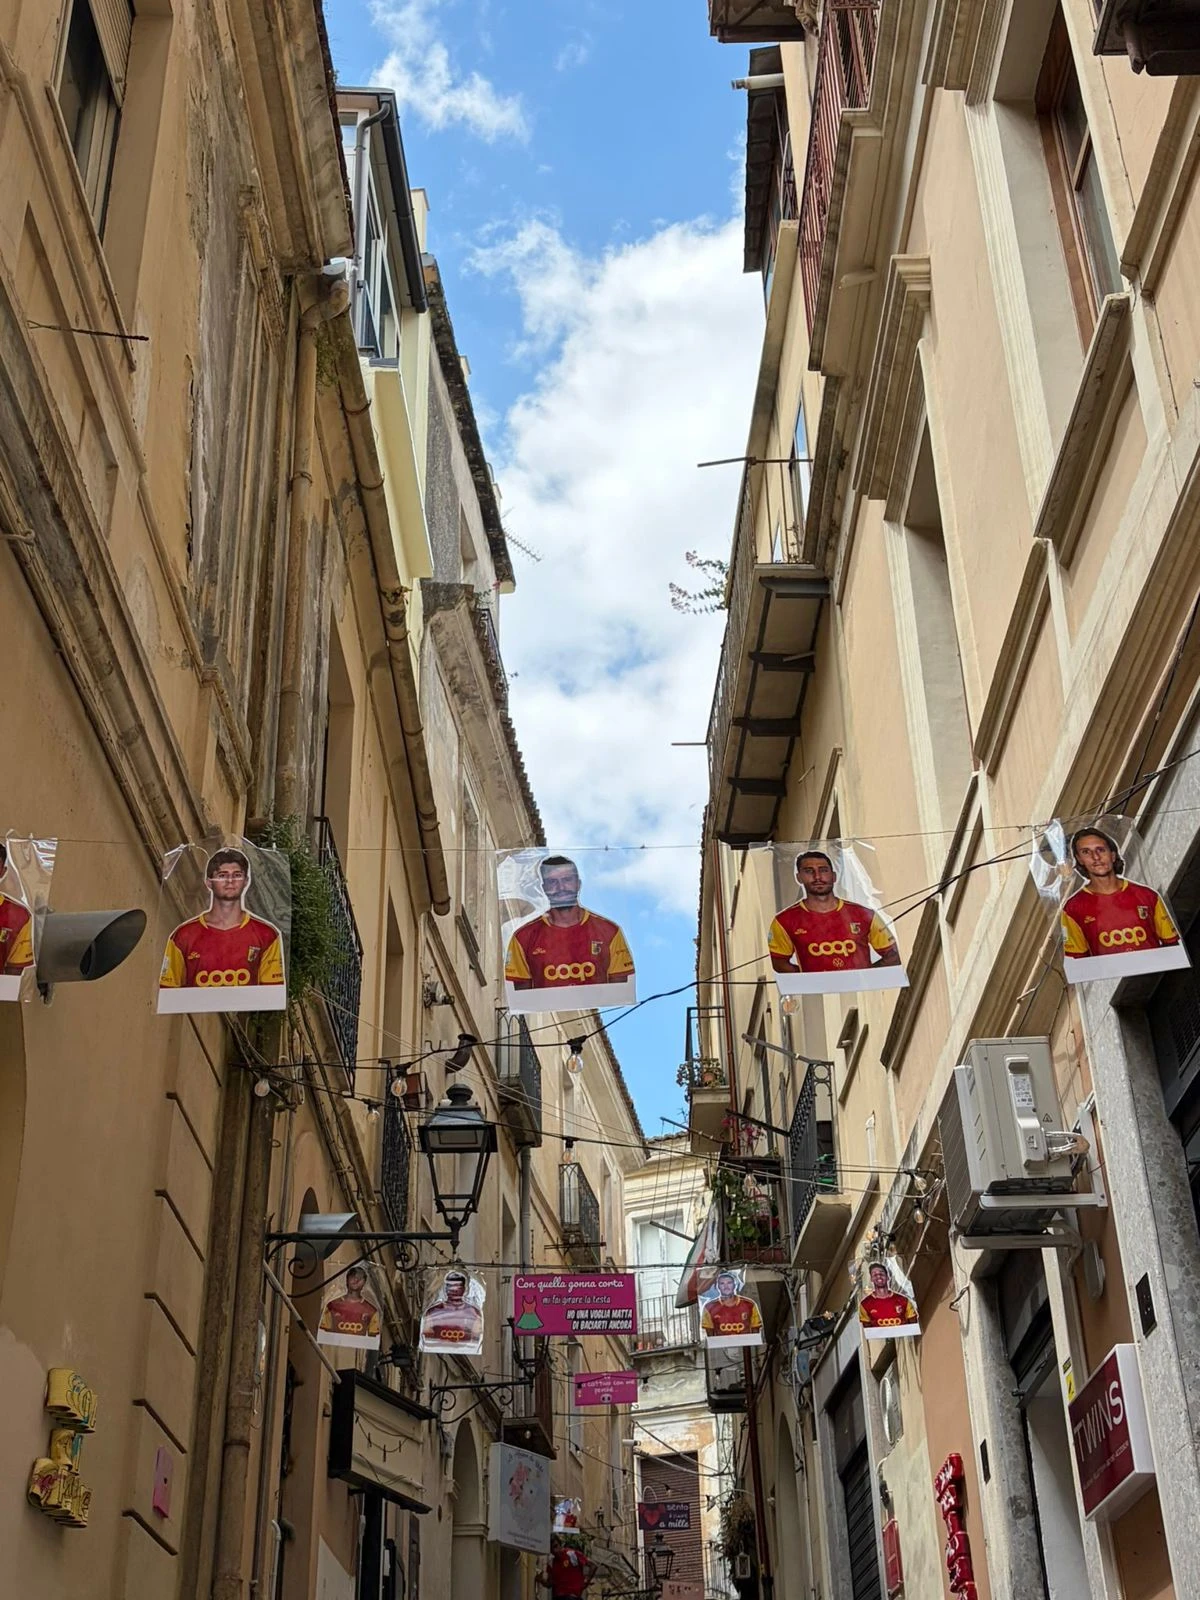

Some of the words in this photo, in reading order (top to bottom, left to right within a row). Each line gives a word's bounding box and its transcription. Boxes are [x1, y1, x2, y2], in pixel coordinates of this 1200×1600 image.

[1099, 924, 1147, 947] coop
[807, 939, 857, 957] coop
[195, 968, 251, 987] coop
[544, 961, 596, 982] coop
[516, 1277, 536, 1289] Con
[537, 1276, 567, 1292] quella
[568, 1280, 597, 1292] gonna
[598, 1279, 624, 1288] corta
[592, 1296, 611, 1304] testa
[576, 1310, 589, 1319] UNA
[590, 1310, 611, 1319] VOGLIA
[611, 1309, 633, 1319] MATTA
[338, 1321, 363, 1333] coop
[572, 1320, 580, 1330] DI
[580, 1320, 607, 1330] BACIARTI
[608, 1320, 632, 1329] ANCORA
[720, 1322, 745, 1333] coop
[877, 1317, 902, 1327] coop
[440, 1330, 465, 1343] coop
[1074, 1380, 1124, 1462] TWINS
[668, 1518, 690, 1528] mille
